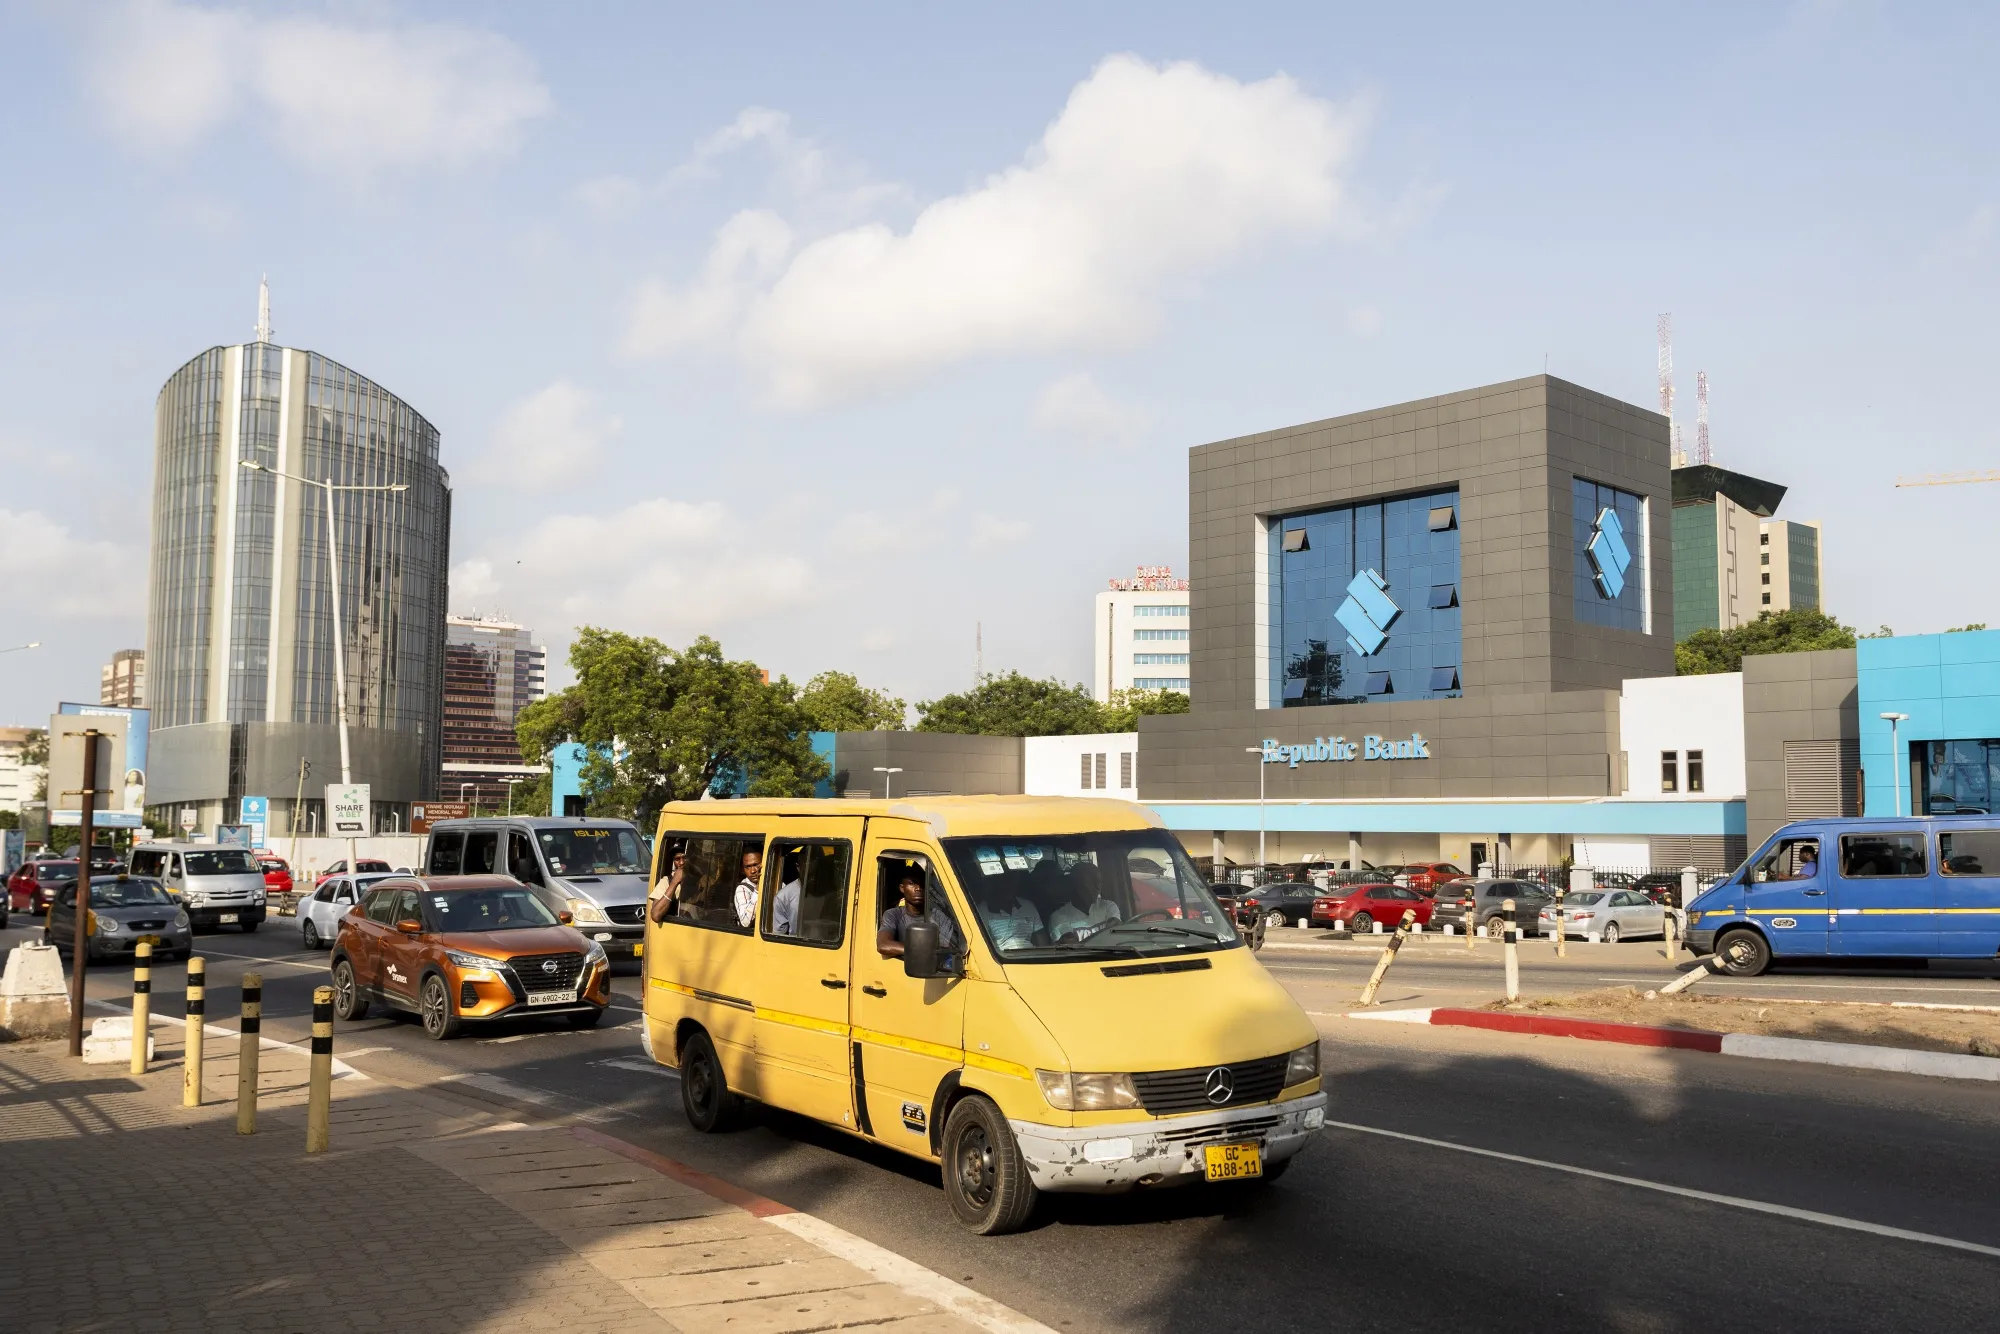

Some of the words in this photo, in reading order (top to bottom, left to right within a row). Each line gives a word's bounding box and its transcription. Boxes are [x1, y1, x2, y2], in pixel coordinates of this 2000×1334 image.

[1136, 566, 1171, 578] GHANA
[1262, 736, 1358, 768] Republic
[1363, 732, 1430, 760] Bank
[1225, 1146, 1239, 1160] GC
[1210, 1160, 1258, 1177] 3188-11
